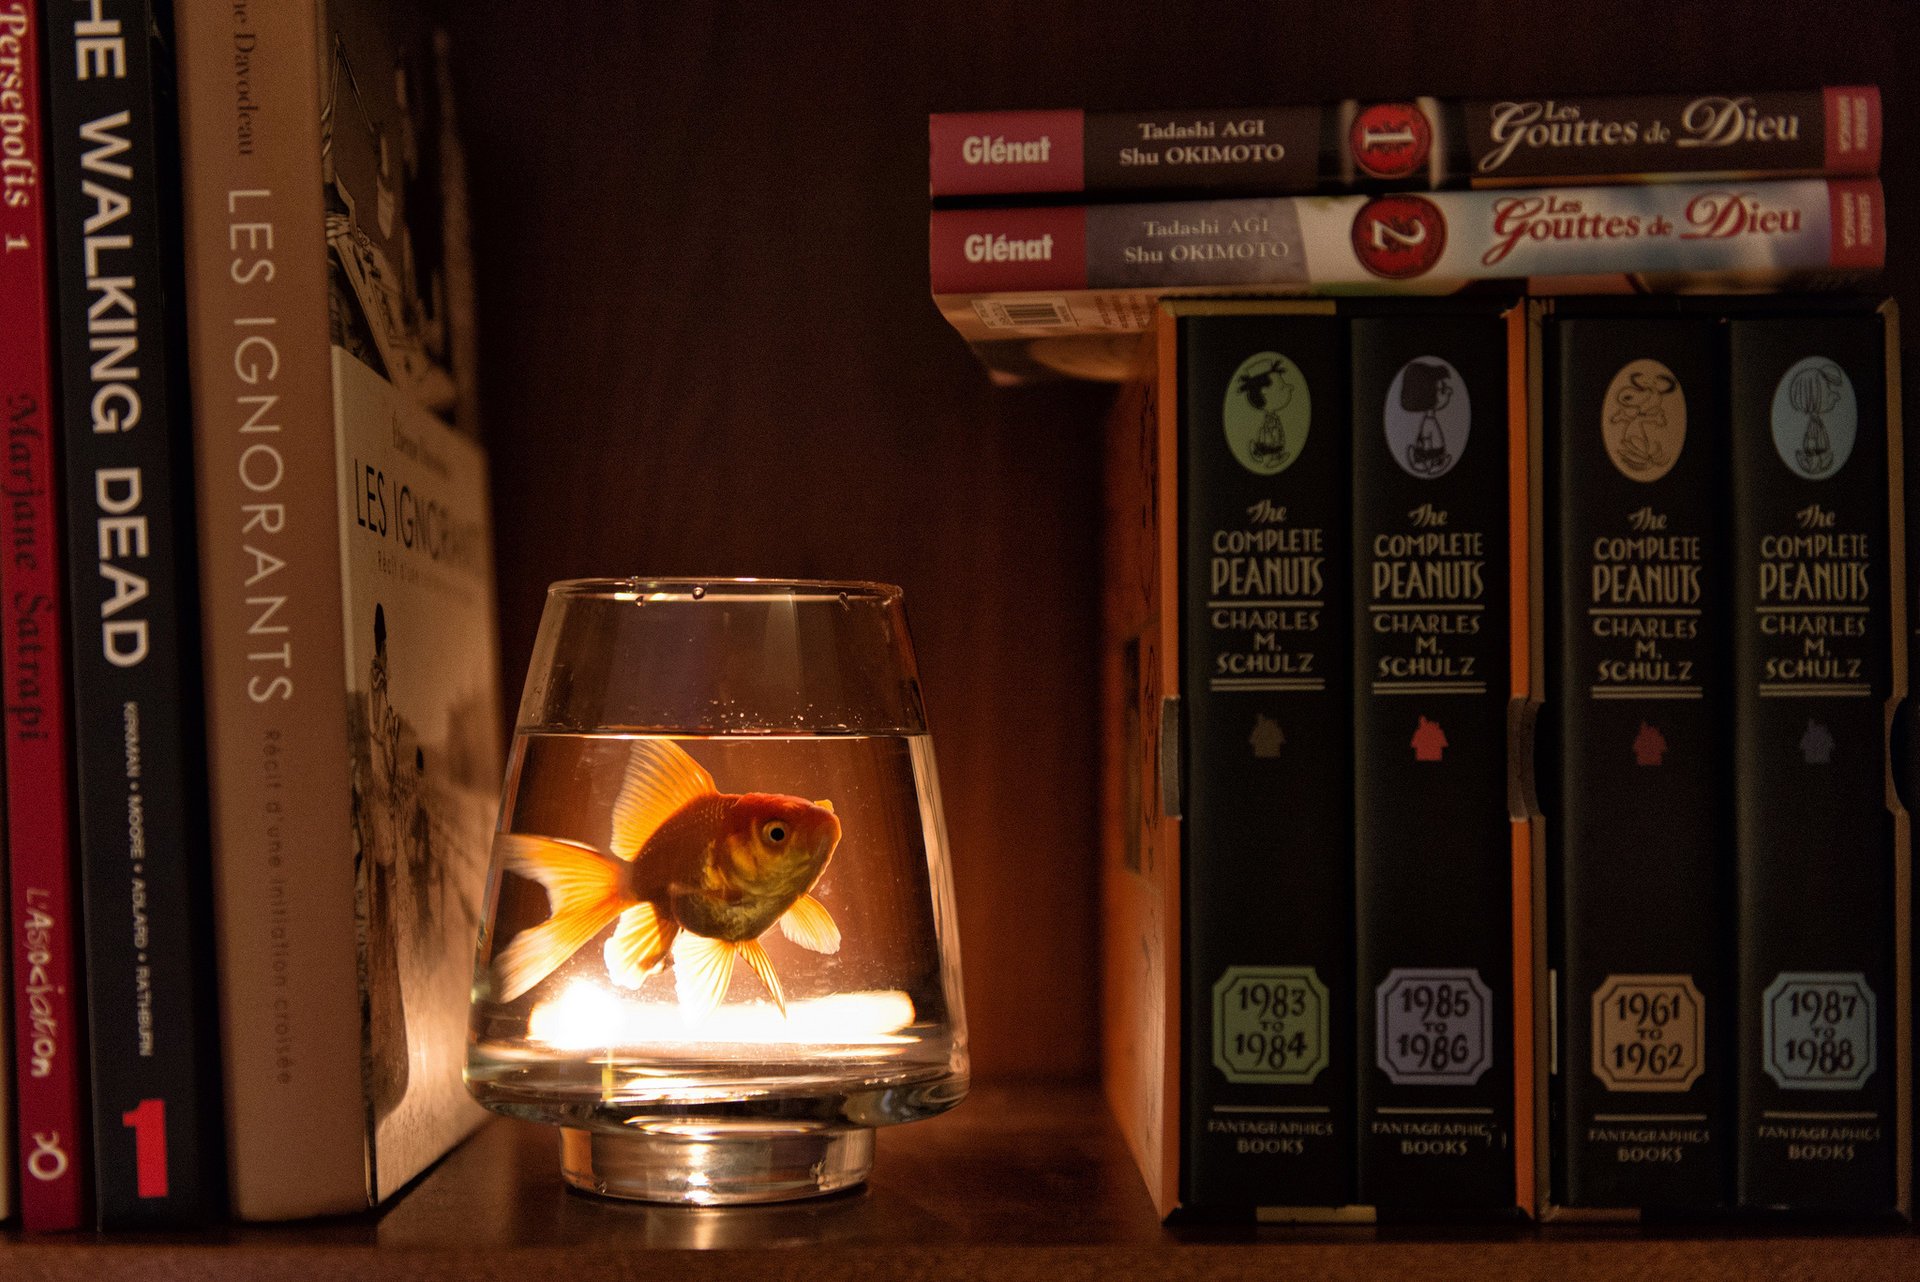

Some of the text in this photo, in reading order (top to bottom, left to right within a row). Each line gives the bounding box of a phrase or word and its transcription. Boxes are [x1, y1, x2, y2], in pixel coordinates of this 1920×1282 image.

[235, 33, 258, 154] Davodeau
[1543, 100, 1581, 121] Les
[0, 3, 36, 253] Persepolis 1
[1138, 119, 1265, 141] Tadashi AGI
[1362, 126, 1416, 151] 1
[1478, 101, 1639, 173] Gouttes
[1643, 120, 1671, 144] de
[1675, 96, 1799, 148] Dieu
[962, 135, 1051, 165] Glénat
[1119, 143, 1285, 166] Shu OKIMOTO
[1547, 196, 1582, 215] Les
[1143, 217, 1269, 238] Tadashi AGI
[1371, 218, 1427, 250] 2
[1482, 197, 1641, 266] Gouttes
[1647, 216, 1673, 236] de
[1679, 193, 1800, 240] Dieu
[964, 233, 1053, 263] Glénat
[1124, 242, 1289, 265] Shu OKIMOTO
[79, 109, 142, 433] WALKING
[228, 190, 293, 703] LES IGNORANTS
[353, 458, 387, 537] LES
[1246, 500, 1288, 523] The
[1408, 503, 1449, 527] The
[1627, 506, 1668, 531] The
[1796, 504, 1836, 528] The
[1212, 528, 1325, 553] COMPLETE
[1373, 532, 1484, 558] COMPLETE
[1593, 535, 1700, 561] COMPLETE
[1760, 534, 1869, 559] COMPLETE
[6, 394, 49, 741] Marjane Satrapi
[95, 467, 149, 668] DEAD
[1210, 556, 1326, 596] PEANUTS
[1372, 560, 1487, 600] PEANUTS
[1592, 564, 1702, 603] PEANUTS
[1759, 561, 1871, 601] PEANUTS
[1210, 609, 1320, 632] CHARLES
[1372, 613, 1481, 635] CHARLES
[1592, 617, 1698, 639] CHARLES
[1759, 615, 1867, 637] CHARLES
[1252, 631, 1282, 652] M.
[1414, 635, 1444, 655] M.
[1634, 639, 1662, 659] M.
[1803, 637, 1831, 657] M.
[1216, 653, 1315, 674] SCHULZ
[1378, 656, 1476, 678] SCHULZ
[1598, 659, 1694, 682] SCHULZ
[1764, 657, 1863, 679] SCHULZ
[128, 795, 145, 859] MOORE
[132, 878, 149, 949] ADLARD
[263, 729, 296, 1085] Récit d'une initiation croisée
[136, 966, 154, 1056] RATHBURN
[1238, 983, 1306, 1020] 1983
[1401, 984, 1470, 1022] 1985
[1617, 993, 1681, 1027] 1961
[1790, 990, 1857, 1026] 1987
[1259, 1021, 1284, 1033] TO
[1424, 1022, 1447, 1033] TO
[1637, 1028, 1663, 1041] TO
[1812, 1027, 1836, 1039] TO
[1235, 1031, 1306, 1070] 1984
[1399, 1033, 1470, 1071] 1986
[1614, 1042, 1684, 1076] 1962
[1785, 1039, 1855, 1076] 1988
[1208, 1120, 1334, 1137] FANTAGRAPHICS
[1371, 1121, 1496, 1138] FANTAGRAPHIC
[1588, 1128, 1711, 1144] FANTAGRAPHICS
[1759, 1125, 1882, 1141] FANTAGRAPHICS
[122, 1098, 169, 1198] 1
[1236, 1138, 1305, 1155] BOOKS
[1400, 1138, 1469, 1156] BOOKS
[1616, 1147, 1683, 1163] BOOKS
[1788, 1145, 1855, 1161] BOOKS
